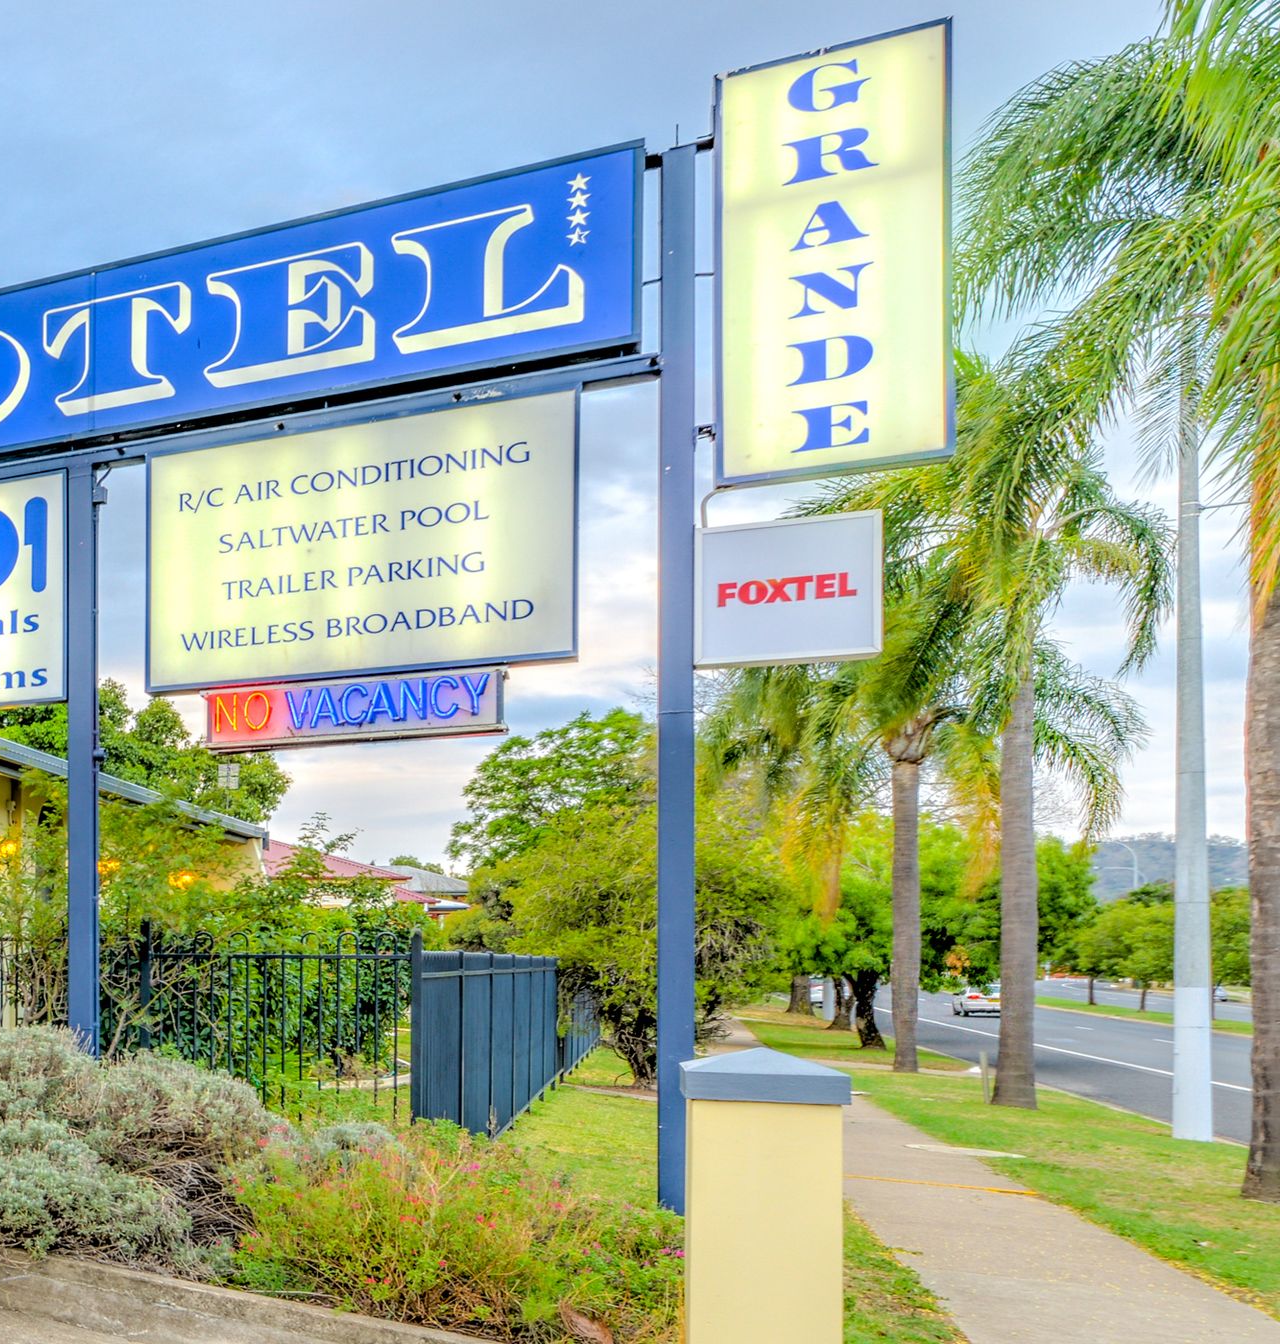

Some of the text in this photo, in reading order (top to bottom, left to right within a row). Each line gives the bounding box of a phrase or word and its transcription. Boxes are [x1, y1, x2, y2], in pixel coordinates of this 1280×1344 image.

[782, 57, 879, 454] GRANDE
[179, 440, 532, 513] R/C AIR CONDITIONING
[218, 499, 490, 555] SALTWATER POOL
[222, 551, 486, 601] TRAILER PARKING
[716, 572, 858, 609] FOXTEL
[180, 598, 535, 652] WIRELESS BROADBAND
[213, 671, 492, 734] NO VACANCY
